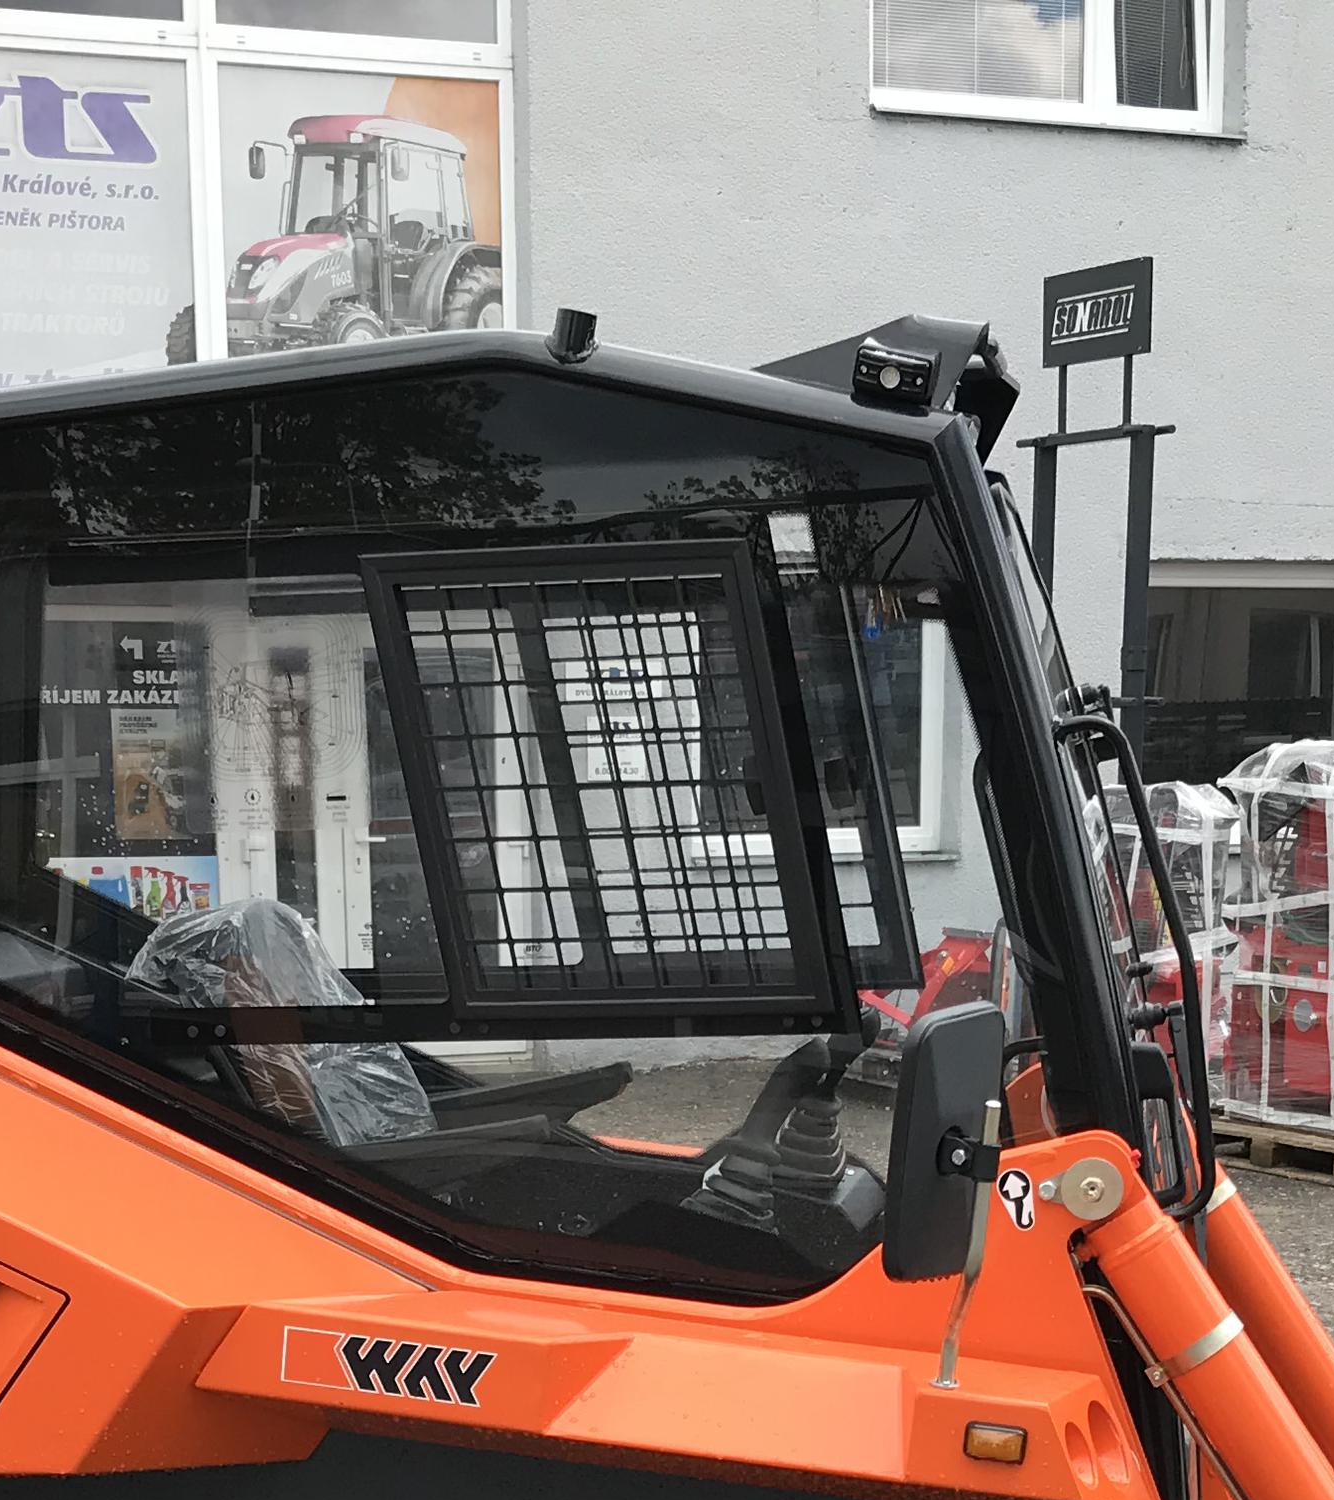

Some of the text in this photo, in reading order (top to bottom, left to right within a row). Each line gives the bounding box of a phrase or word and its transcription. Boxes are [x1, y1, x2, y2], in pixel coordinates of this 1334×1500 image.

[2, 173, 97, 199] Králové,
[105, 183, 160, 200] s.r.o.
[48, 210, 126, 231] PIŠTORA
[40, 684, 101, 705] ŘÍJEM
[334, 1335, 499, 1407] WAY
